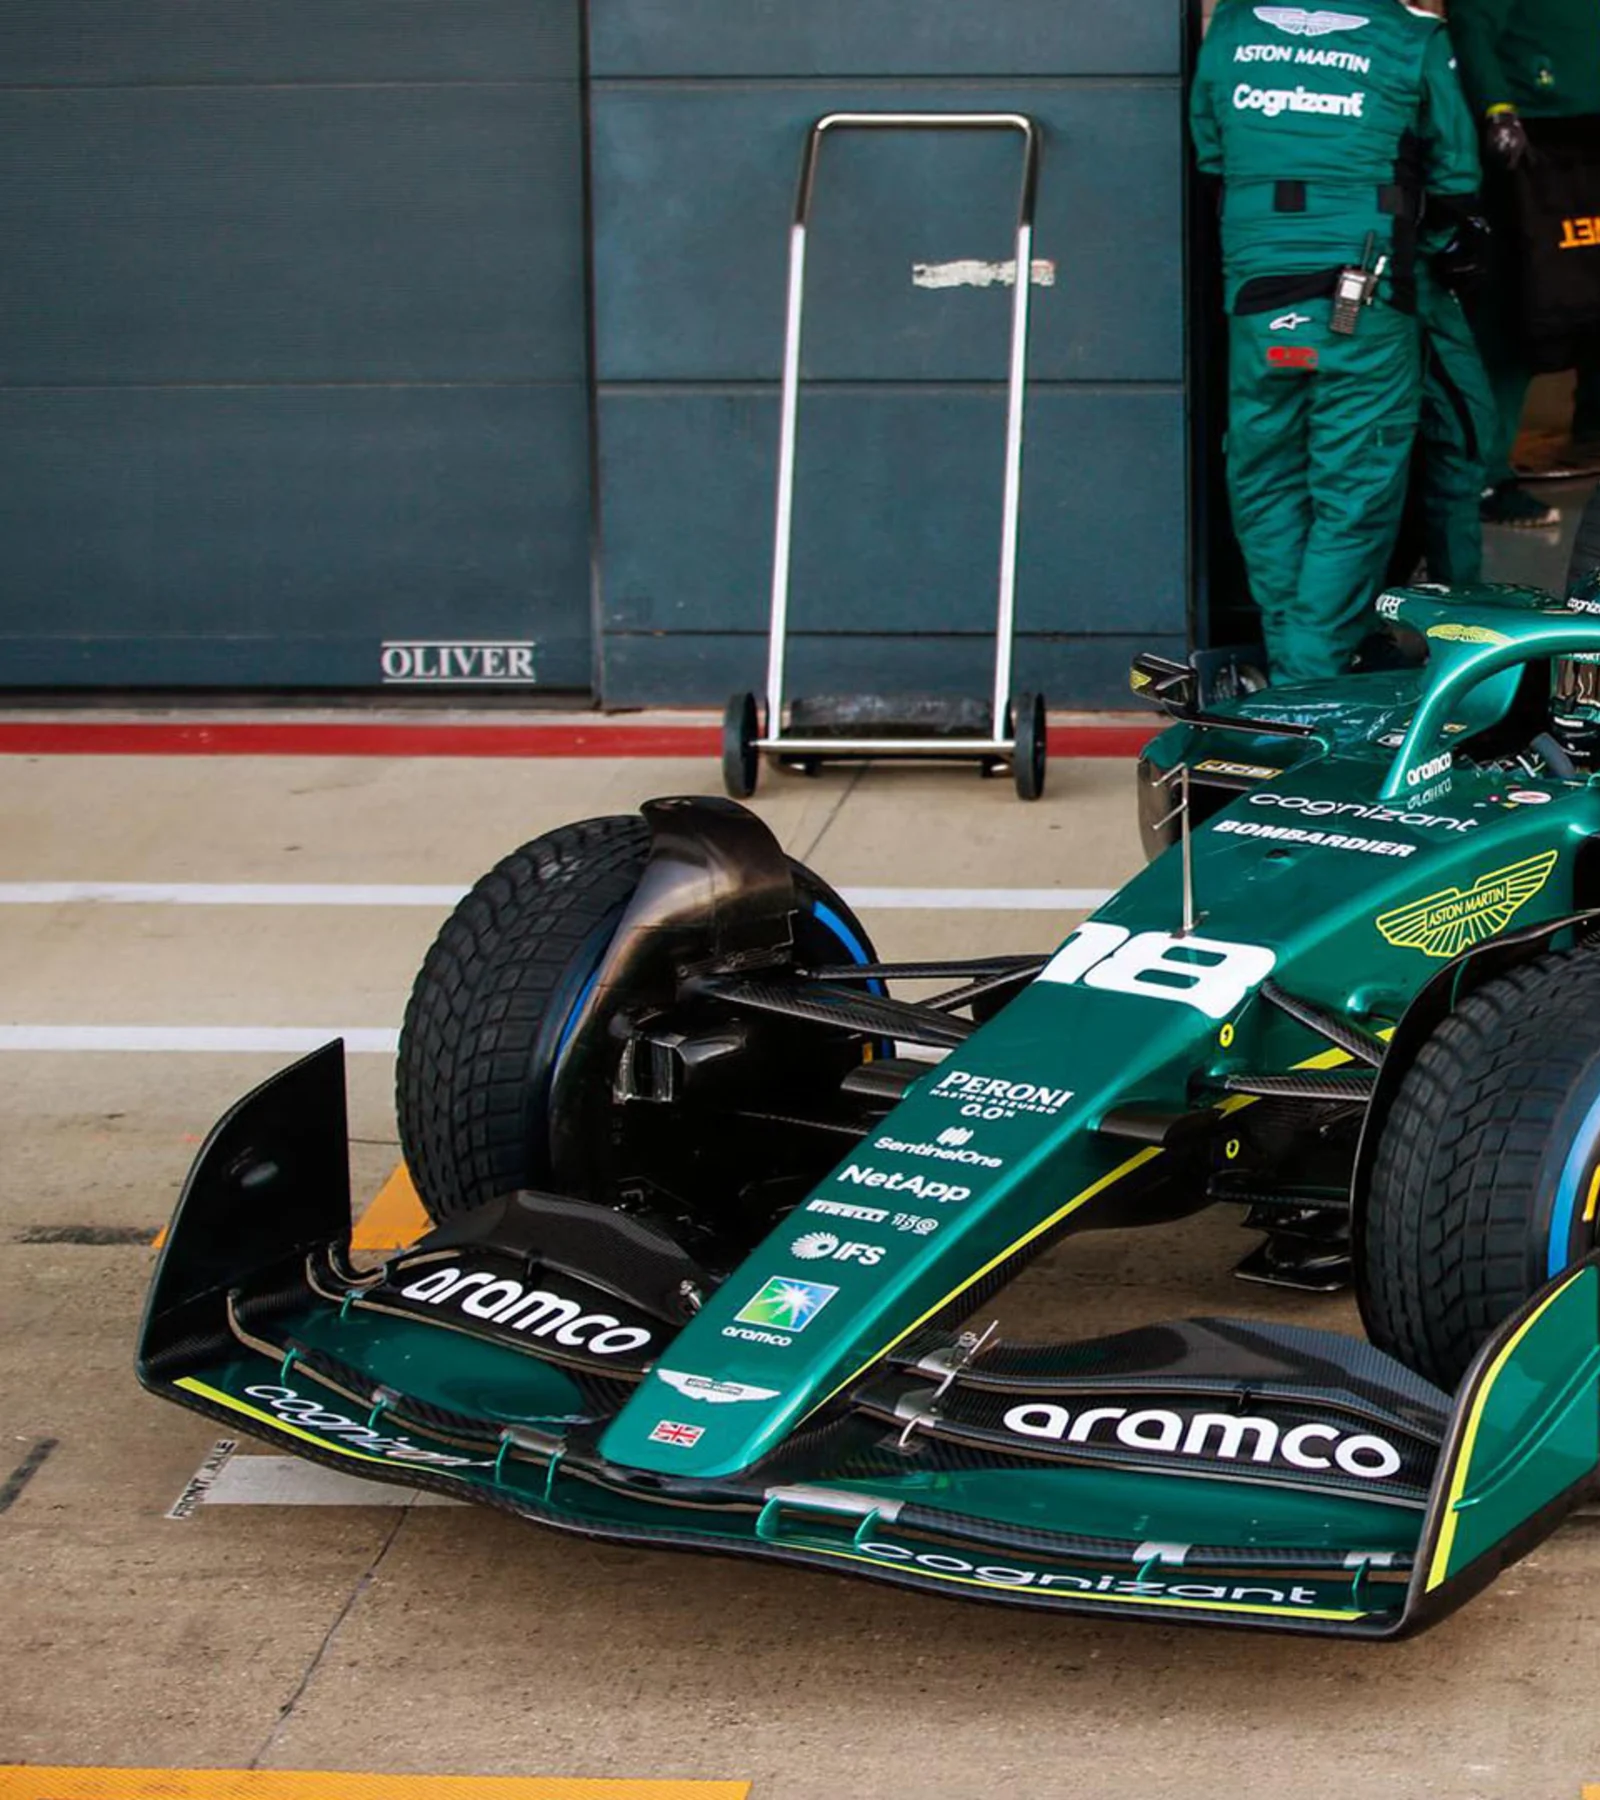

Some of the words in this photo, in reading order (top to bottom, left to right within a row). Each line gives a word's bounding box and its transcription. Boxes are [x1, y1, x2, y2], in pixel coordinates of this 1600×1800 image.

[1233, 44, 1293, 62] ASTON
[1294, 47, 1370, 74] MARTIN
[1232, 83, 1365, 117] Cognizant
[381, 648, 534, 678] OLIVER
[1407, 751, 1452, 787] aramco
[1249, 793, 1479, 833] cognizant
[1212, 819, 1417, 857] BOMBARDIER
[1427, 901, 1464, 928] ASTON
[1464, 885, 1505, 914] MARTIN
[1032, 921, 1277, 1019] 18
[929, 1088, 988, 1104] NASTRO
[986, 1097, 1057, 1116] AZZURRO
[937, 1070, 1075, 1108] PERONI
[873, 1136, 1003, 1168] SentinelOne
[838, 1164, 972, 1203] NetApp
[806, 1199, 891, 1223] PIRELLI
[832, 1241, 887, 1266] IFS
[402, 1266, 653, 1356] aramco
[721, 1325, 793, 1347] aramco
[1003, 1402, 1401, 1479] aramco
[172, 1477, 206, 1518] FRONT
[860, 1541, 1318, 1604] cognizant
